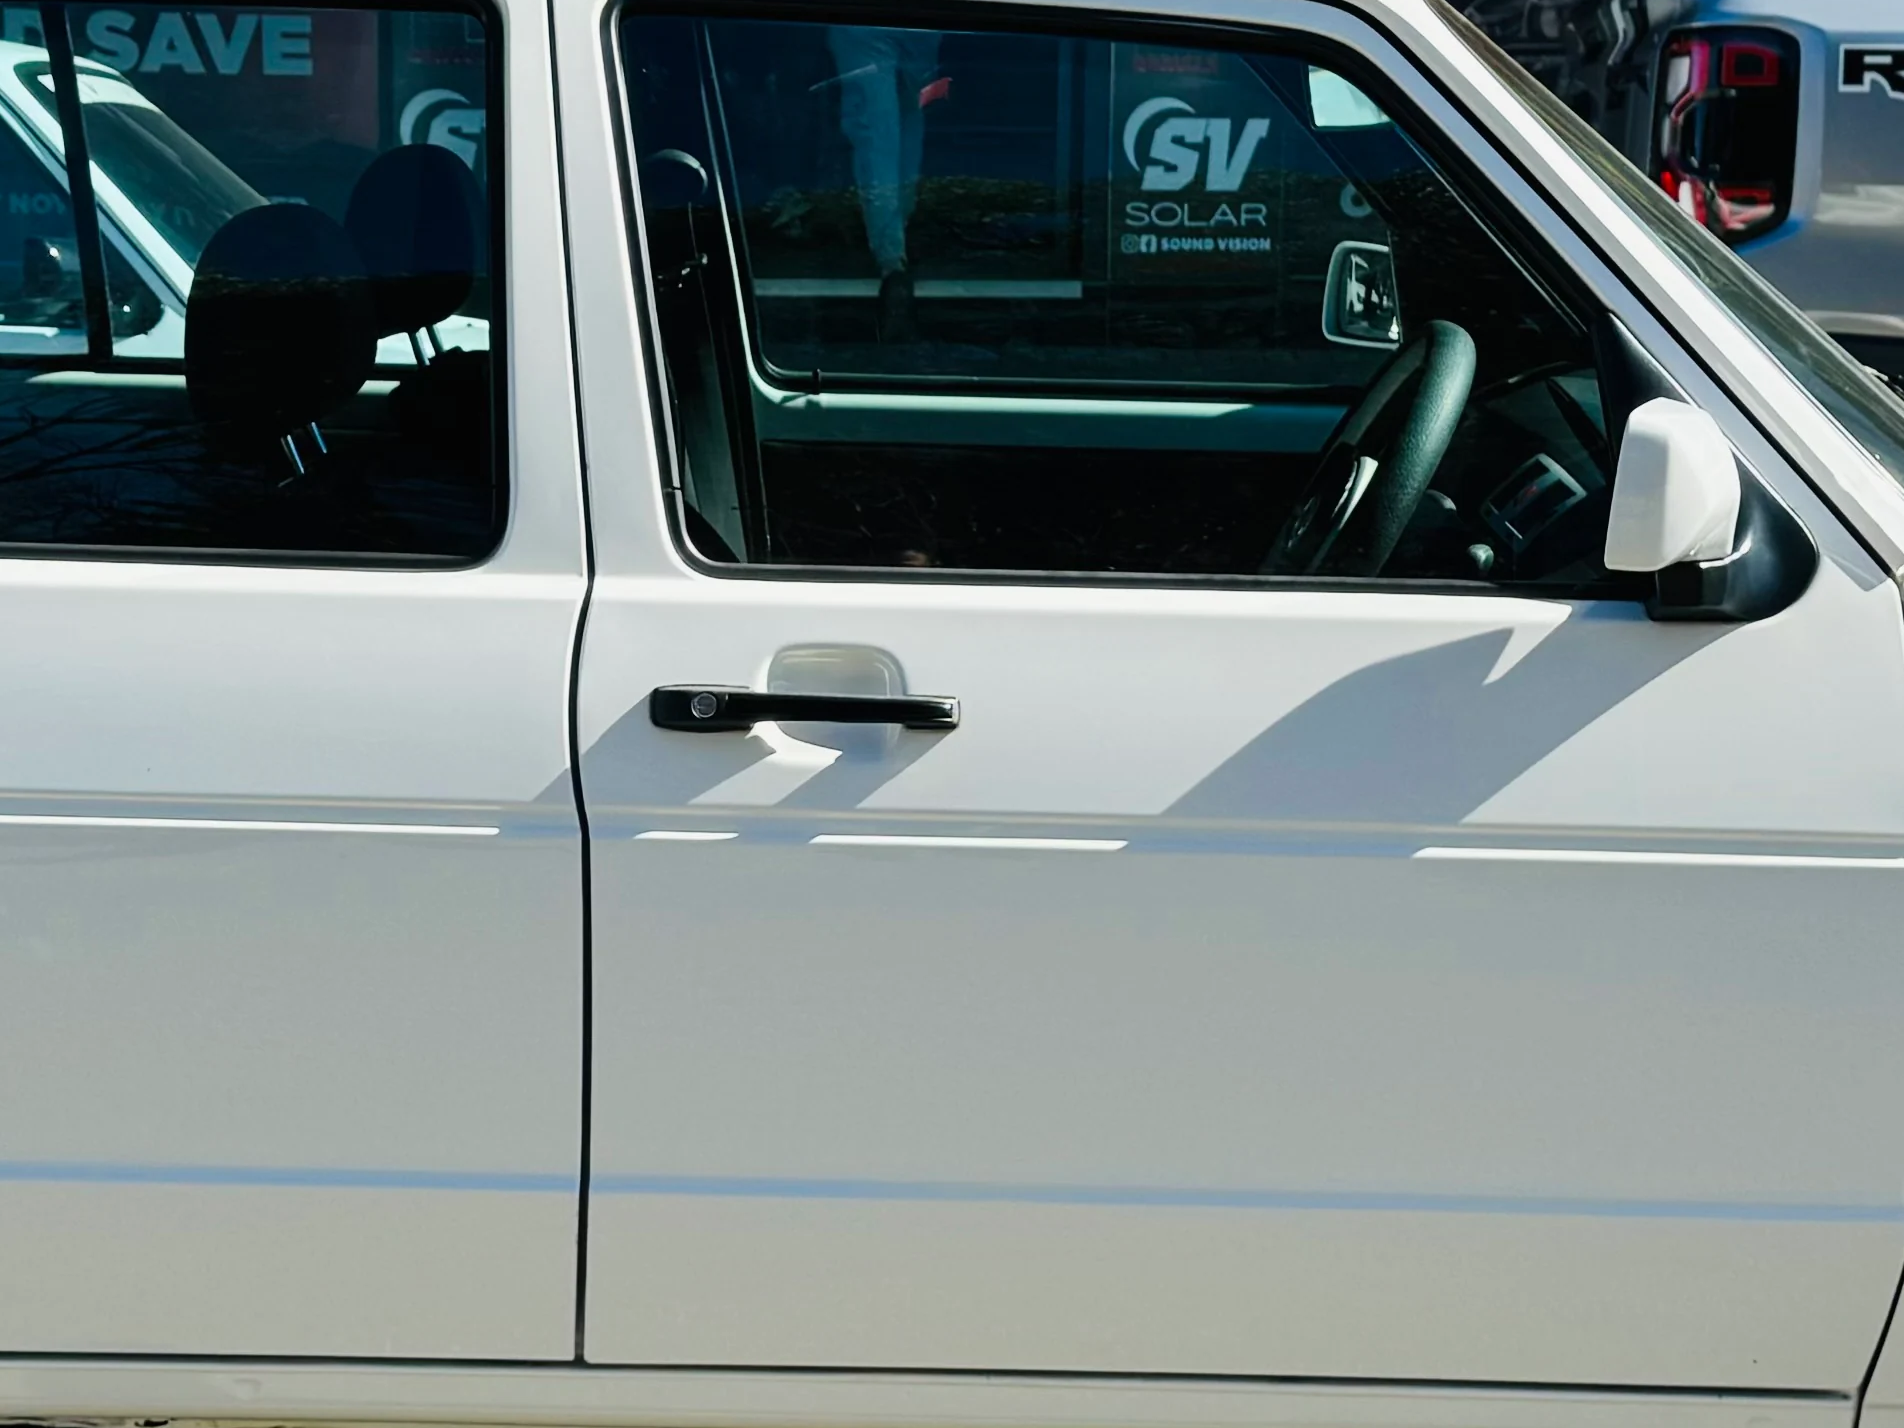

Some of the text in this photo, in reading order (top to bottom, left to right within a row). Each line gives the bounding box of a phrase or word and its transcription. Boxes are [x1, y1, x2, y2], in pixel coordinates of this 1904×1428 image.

[86, 9, 313, 76] SAVE
[1141, 118, 1270, 191] SV
[1125, 202, 1267, 226] SOLAR
[1160, 237, 1271, 252] SOUND VISION
